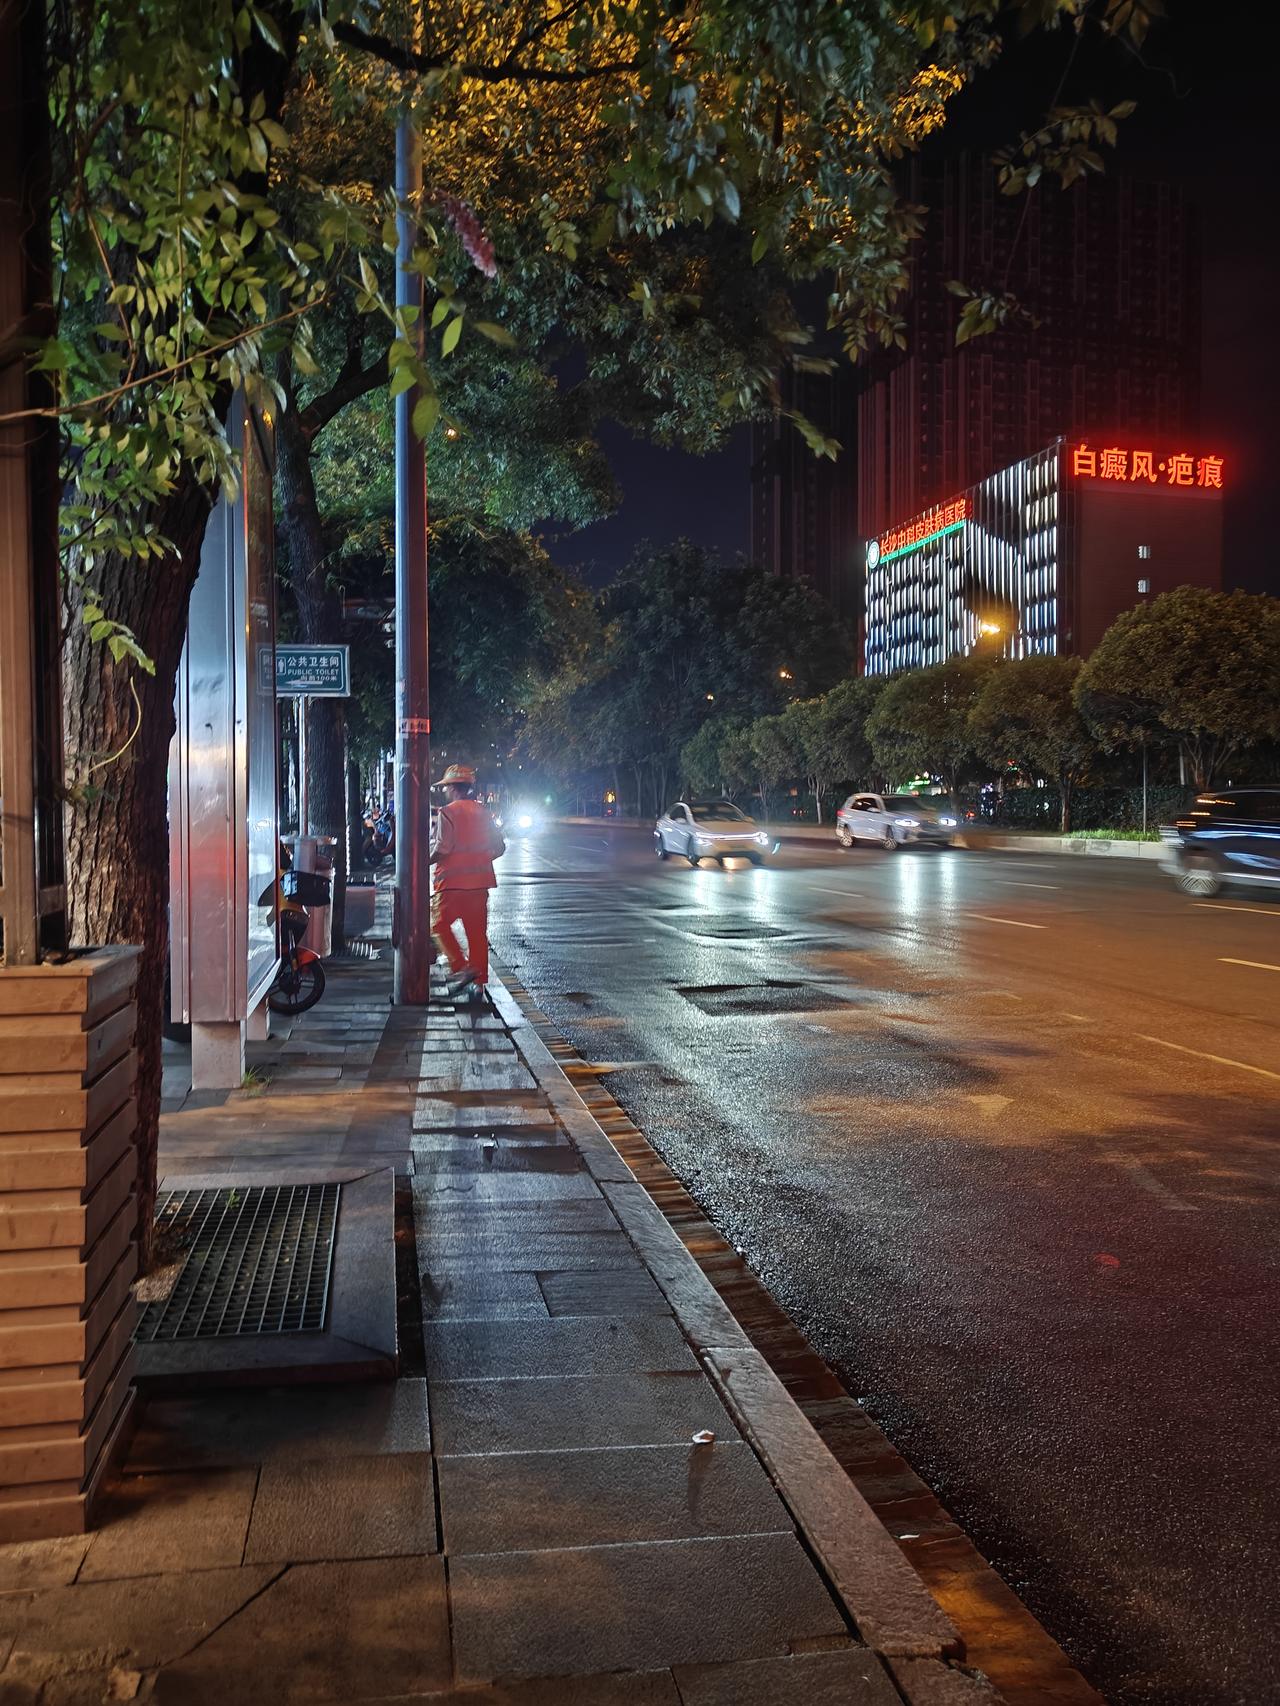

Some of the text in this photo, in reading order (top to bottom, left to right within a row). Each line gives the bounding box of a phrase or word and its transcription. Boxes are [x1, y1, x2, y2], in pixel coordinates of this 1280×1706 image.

[1073, 443, 1225, 489] 白癜风·疤痕
[880, 498, 966, 557] 长沙中科皮肤病医院
[287, 656, 339, 667] 公共卫生间
[287, 668, 339, 676] PUBLIC TOILET
